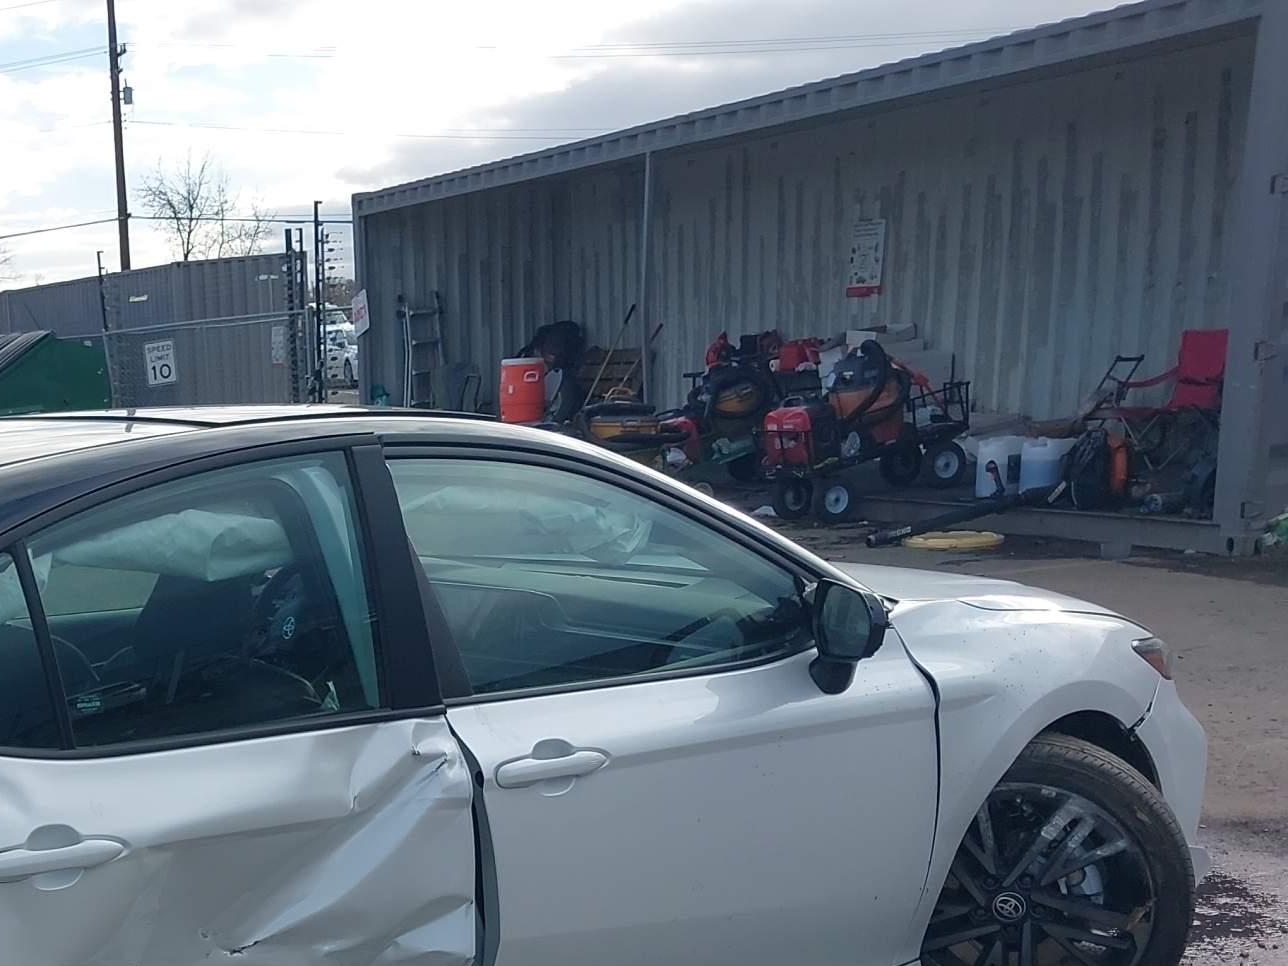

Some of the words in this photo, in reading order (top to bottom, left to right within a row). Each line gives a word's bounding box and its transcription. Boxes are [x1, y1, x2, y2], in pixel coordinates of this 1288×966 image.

[146, 344, 172, 353] SPEED
[150, 353, 169, 362] LIMIT
[152, 364, 172, 381] 10
